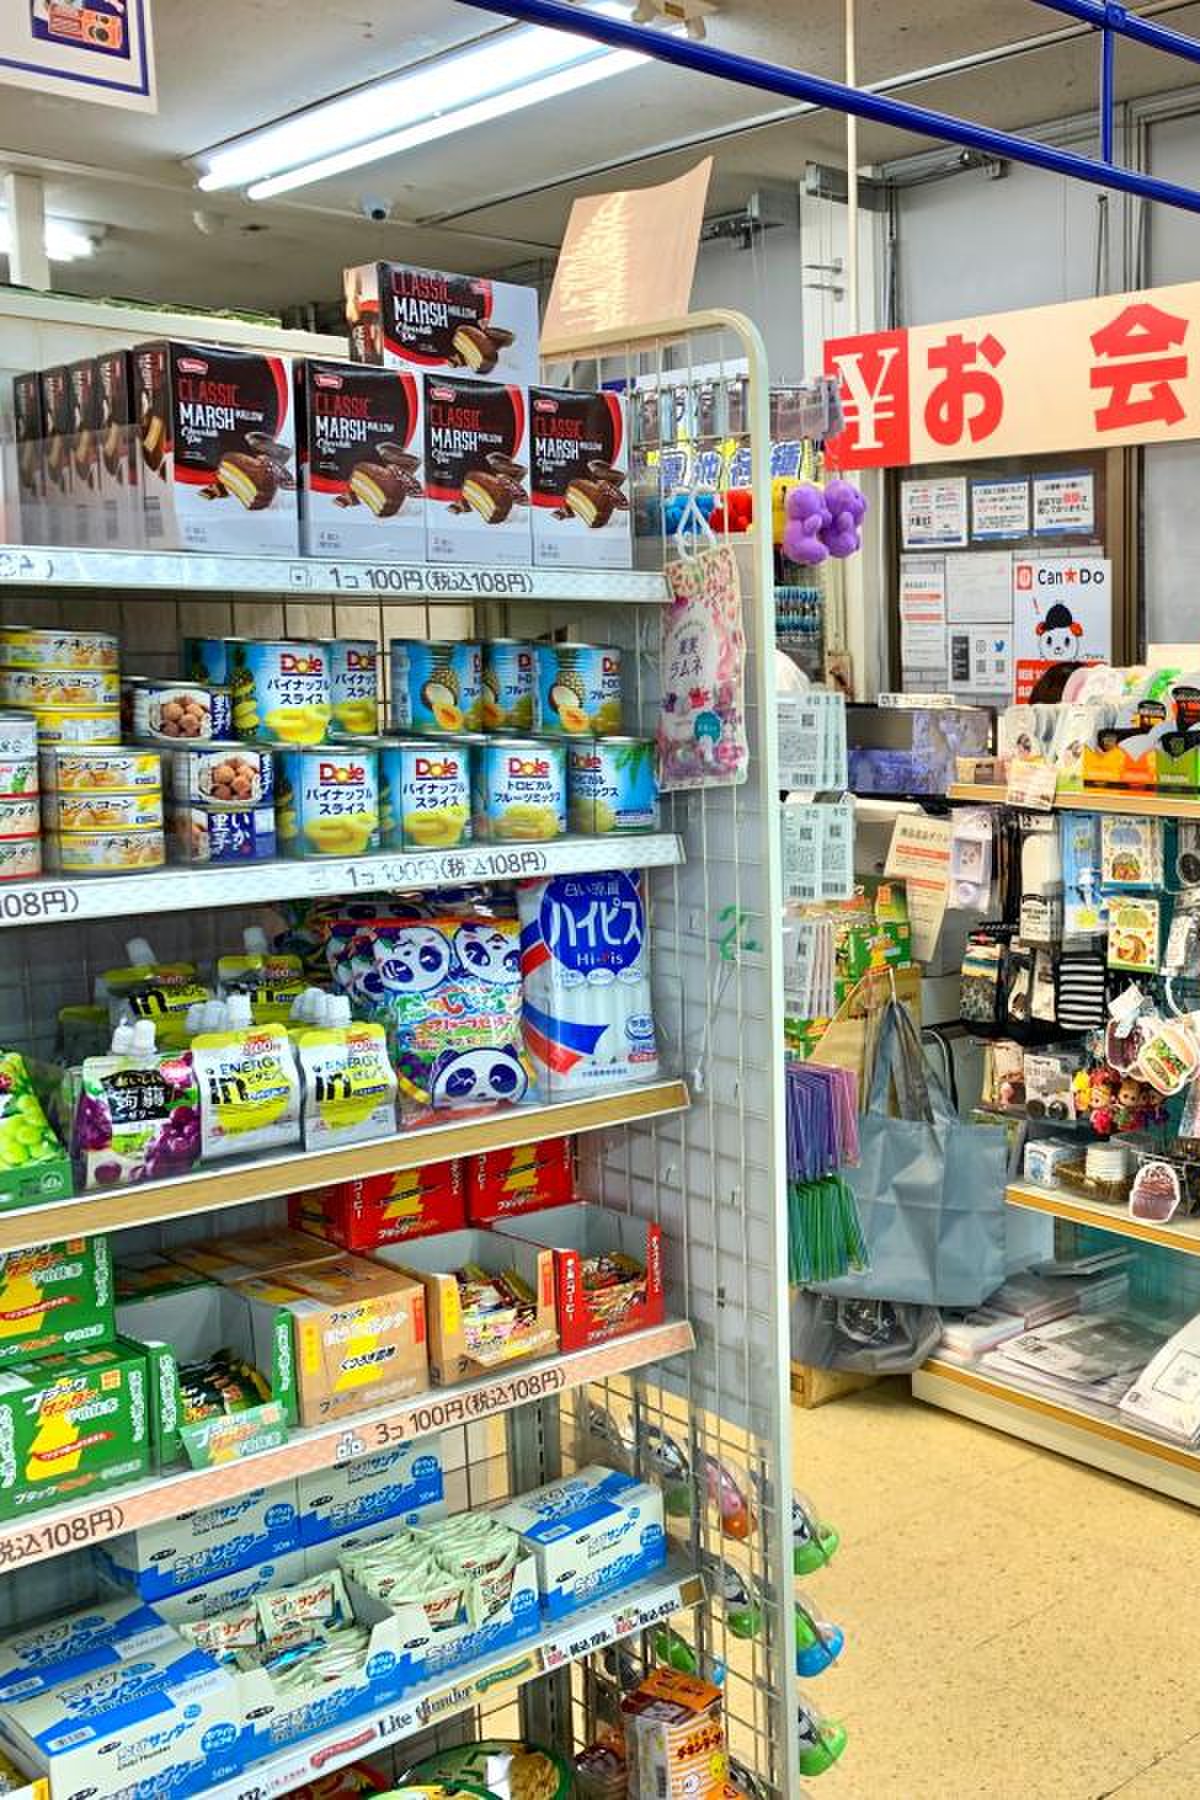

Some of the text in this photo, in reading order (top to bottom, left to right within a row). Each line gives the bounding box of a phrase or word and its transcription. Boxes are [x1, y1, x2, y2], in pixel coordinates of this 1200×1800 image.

[391, 271, 450, 299] CLASSIC
[393, 296, 449, 328] MARSH
[177, 378, 239, 406] CLASSIC
[315, 394, 370, 416] CLASSIC
[179, 402, 235, 432] MARSH
[430, 404, 482, 429] CLASSIC
[315, 416, 367, 442] MARSH
[431, 427, 479, 451] MARSH
[535, 438, 580, 460] MARSH
[366, 568, 534, 593] 100円(税込108円)
[280, 652, 323, 674] Dole
[267, 678, 330, 691] パイナップル
[280, 692, 325, 705] スライス
[319, 761, 365, 783] Dole
[415, 757, 458, 778] Dole
[509, 757, 550, 776] Dole
[306, 789, 372, 801] パイナップル
[403, 782, 465, 795] パイナップル
[506, 780, 553, 792] トロピカル
[319, 803, 366, 816] スライス
[415, 797, 460, 809] スライス
[0, 887, 79, 918] 08円)
[551, 897, 642, 947] ハイピス
[219, 1056, 282, 1076] ENERGY
[325, 1054, 379, 1073] ENERGY
[375, 1366, 567, 1445] 3コ 100円(税込108円)
[378, 1713, 414, 1738] Lite
